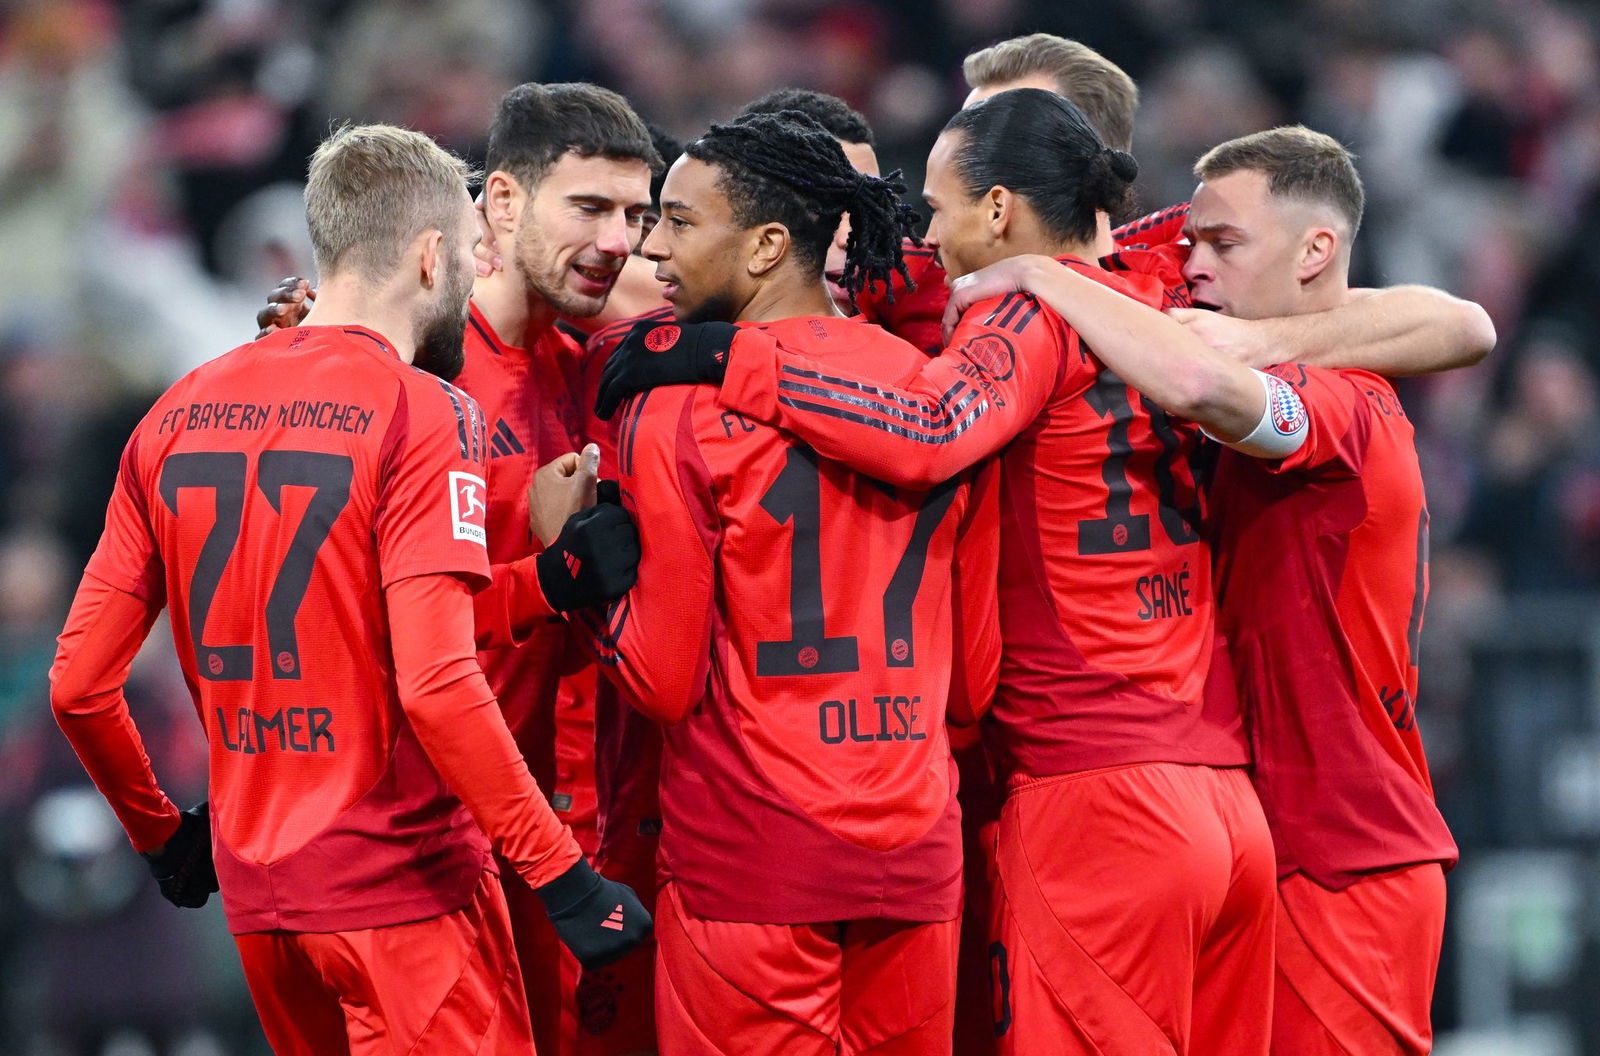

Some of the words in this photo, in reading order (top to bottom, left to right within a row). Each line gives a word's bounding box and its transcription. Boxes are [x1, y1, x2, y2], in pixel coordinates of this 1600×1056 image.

[159, 408, 185, 434] FC
[186, 403, 272, 431] BAYERN
[276, 400, 375, 435] MÜNCHEN
[720, 410, 757, 438] FC
[158, 450, 355, 682] 27
[756, 446, 962, 677] 17
[1135, 561, 1193, 620] SANÉ
[216, 707, 335, 755] LAIMER
[818, 695, 927, 744] OLISE
